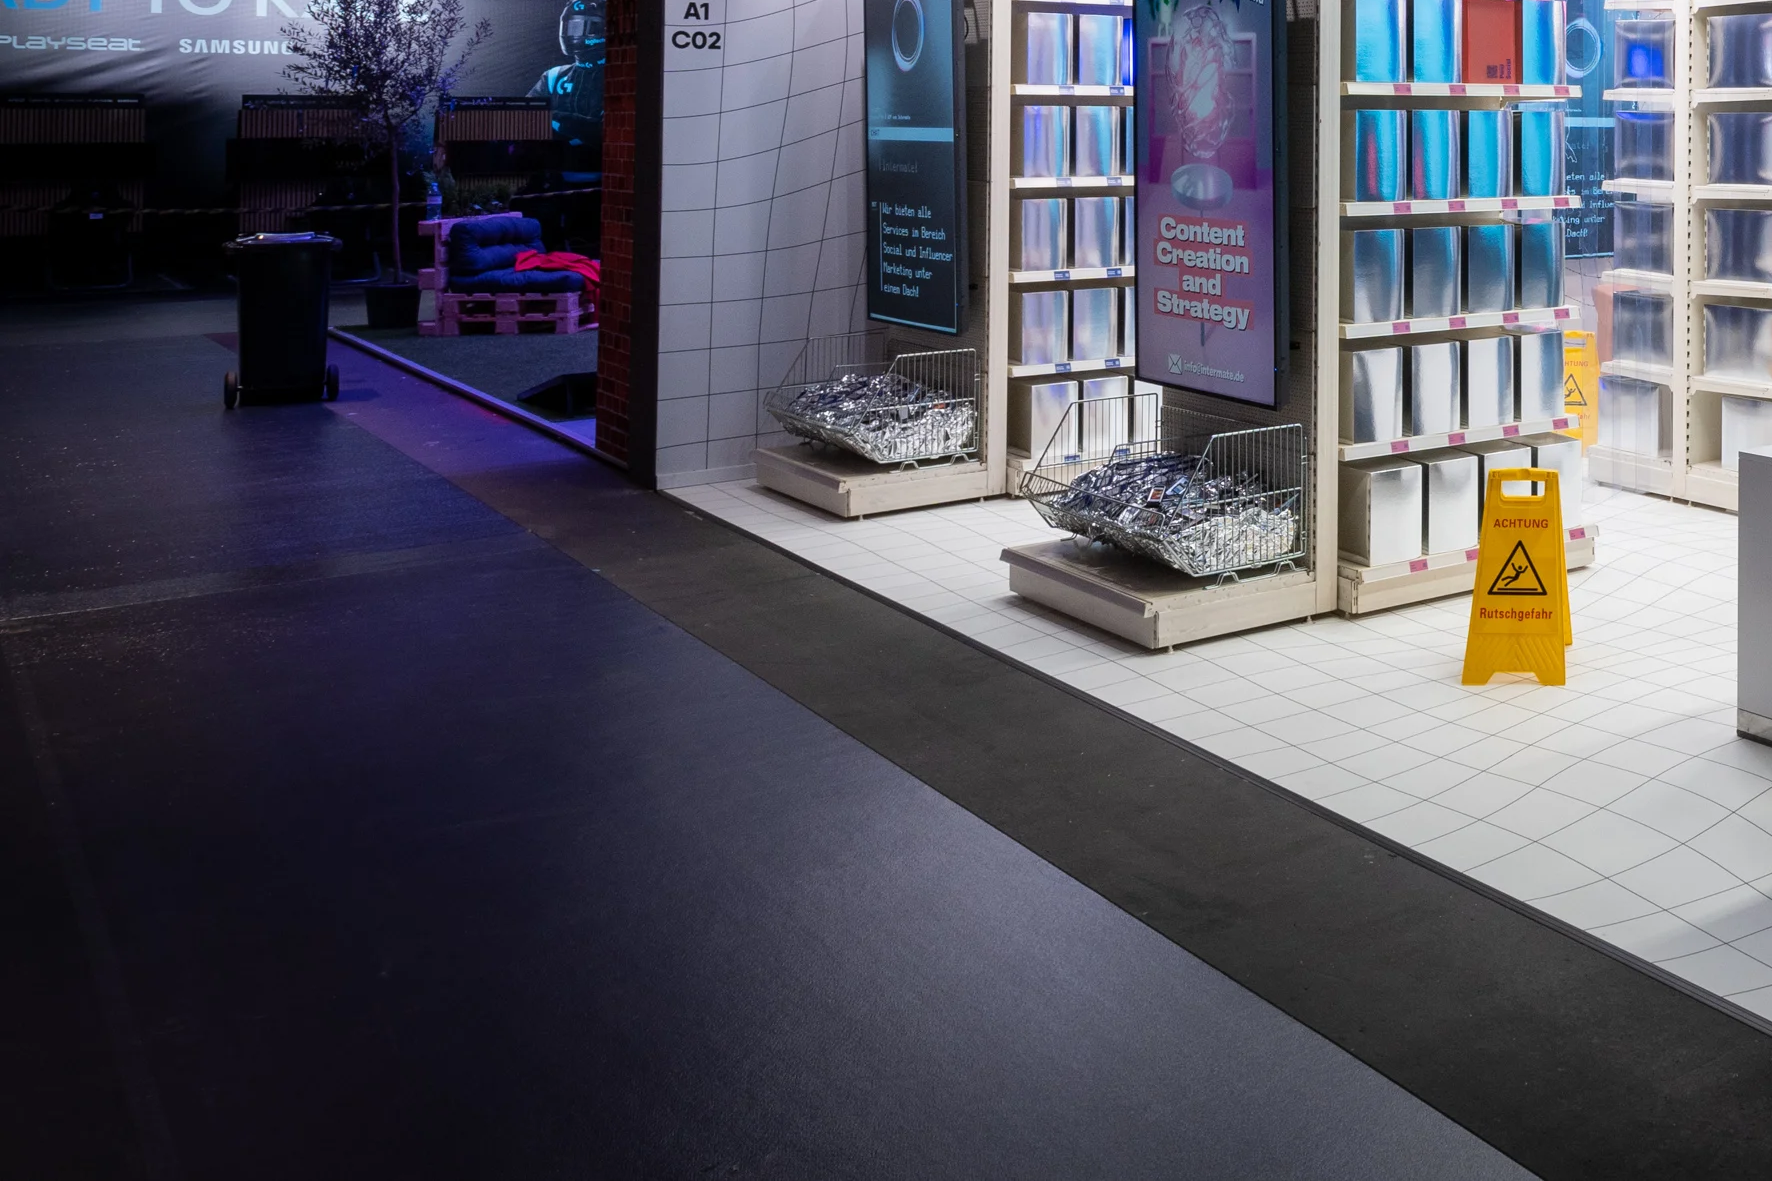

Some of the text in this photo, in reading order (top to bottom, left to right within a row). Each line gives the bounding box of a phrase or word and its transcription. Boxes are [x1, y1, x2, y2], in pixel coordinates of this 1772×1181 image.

[683, 2, 710, 21] A1
[671, 30, 722, 50] C02
[882, 202, 932, 219] Wir bieten alle
[882, 222, 909, 237] Services
[921, 226, 946, 241] Bereich
[1160, 216, 1246, 247] Content
[883, 241, 954, 262] Social und Influencer
[1156, 241, 1250, 274] Creation
[883, 261, 933, 279] Marketing unter
[902, 282, 920, 298] Dach!
[1182, 273, 1222, 296] and
[1157, 290, 1251, 331] Strategy
[1184, 359, 1245, 382] info@intermate.de
[1493, 518, 1549, 529] ACHTUNG
[1480, 607, 1553, 622] Rutschgefahr
